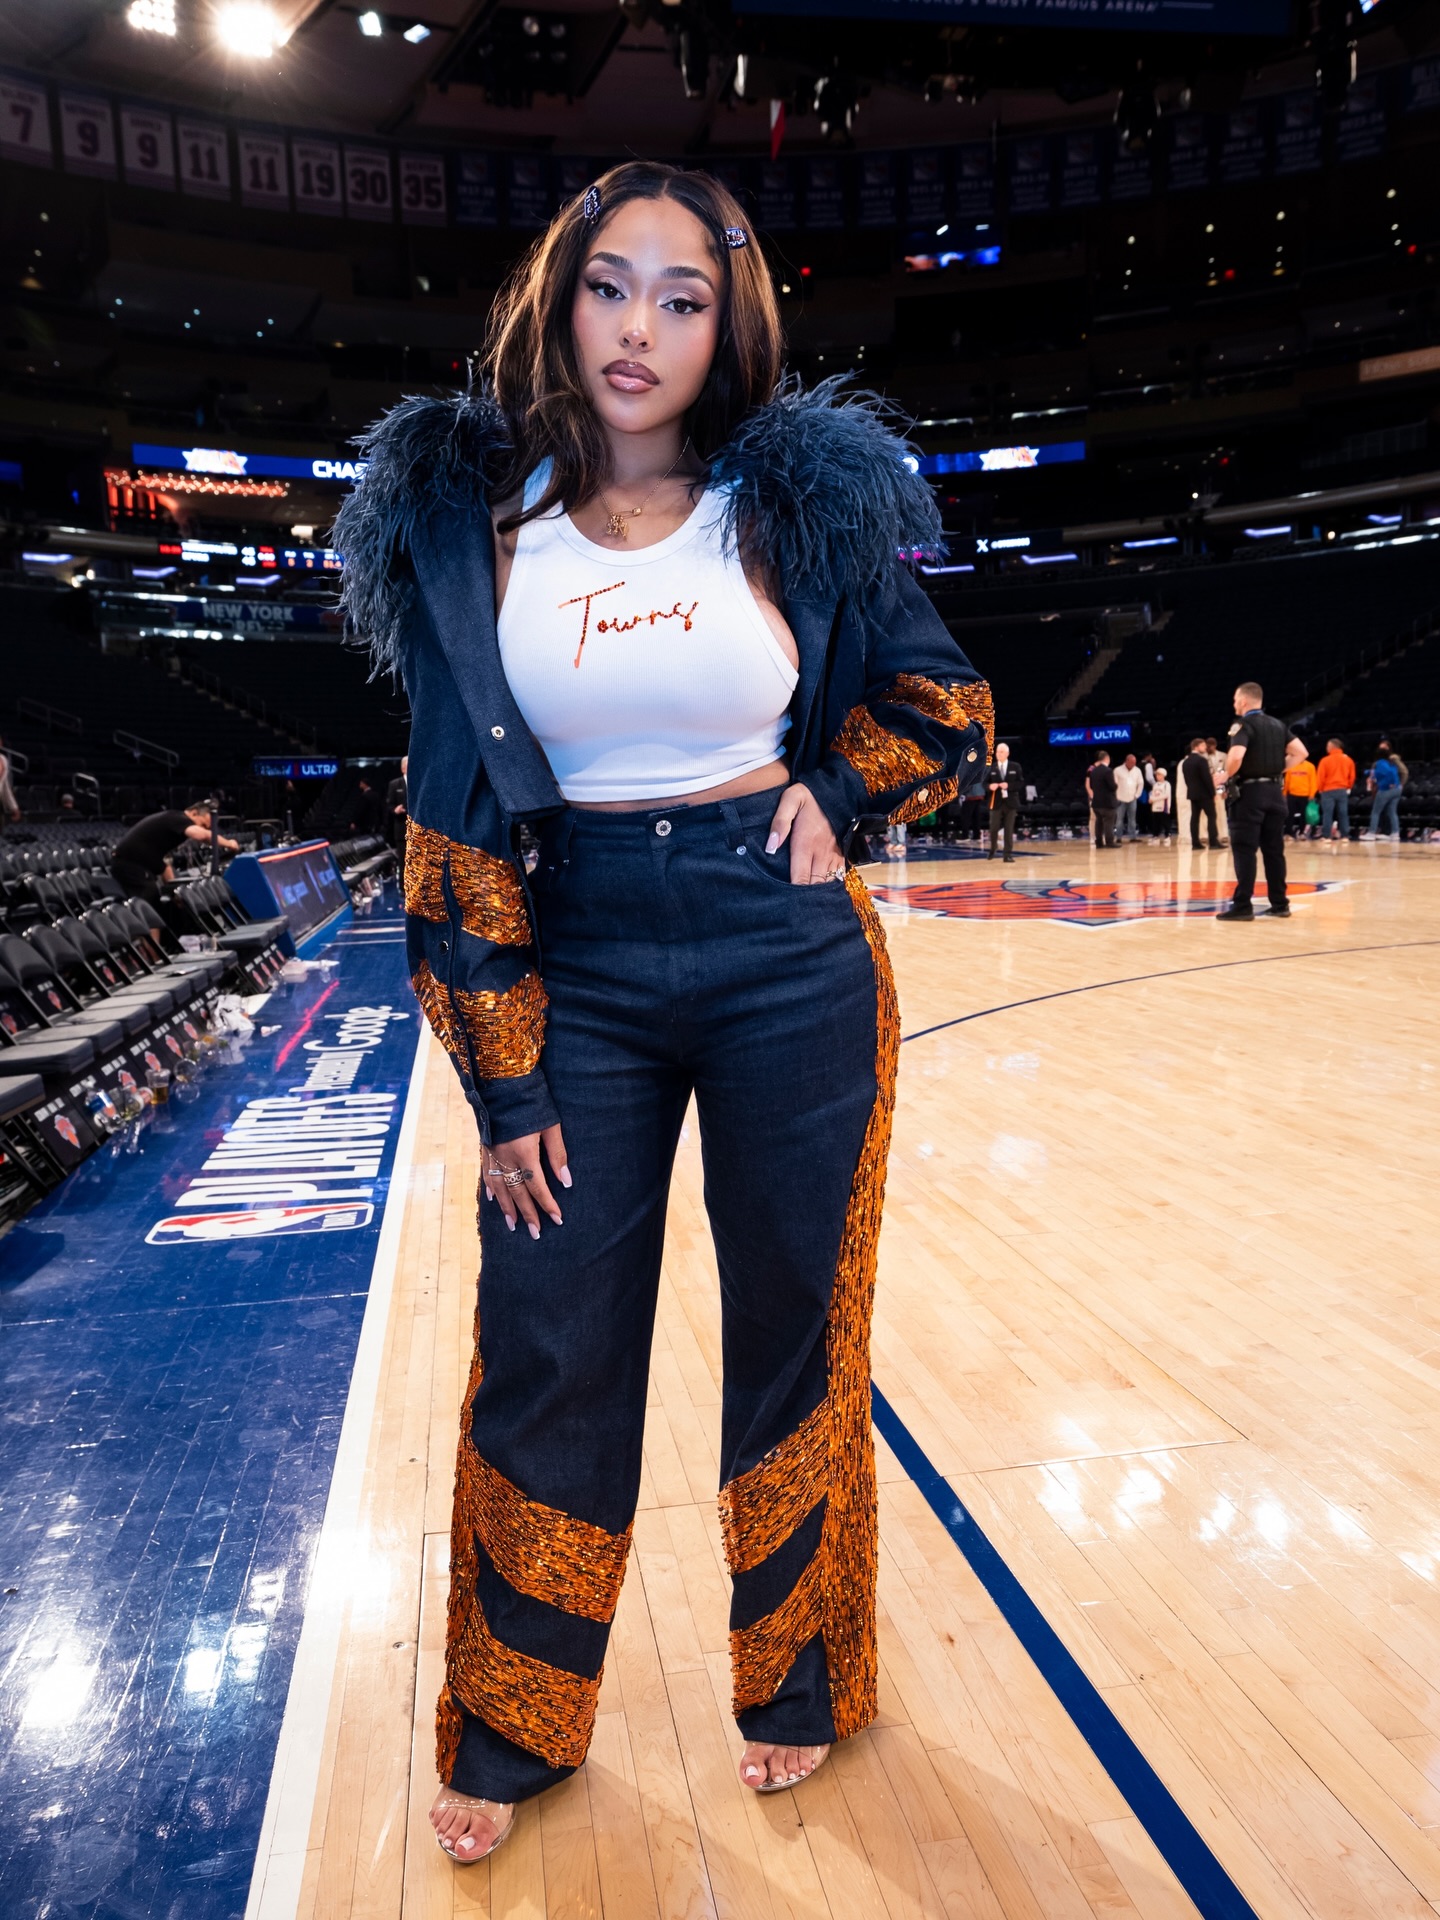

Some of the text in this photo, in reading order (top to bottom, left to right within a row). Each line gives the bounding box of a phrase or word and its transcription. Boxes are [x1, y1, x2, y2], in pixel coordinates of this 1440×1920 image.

[1104, 0, 1159, 13] ARENA
[10, 103, 33, 143] 7
[77, 119, 99, 157] 9
[137, 132, 159, 169] 9
[188, 143, 220, 181] 11
[248, 155, 279, 192] 11
[300, 161, 335, 198] 19
[349, 167, 389, 204] 30
[403, 173, 442, 210] 35
[202, 602, 294, 621] NEW YORK
[558, 581, 699, 669] Towns
[1094, 729, 1130, 740] ULTRA
[302, 764, 338, 775] ULTRA
[303, 1005, 410, 1051] Google
[175, 1093, 397, 1207] PLAYOFFS
